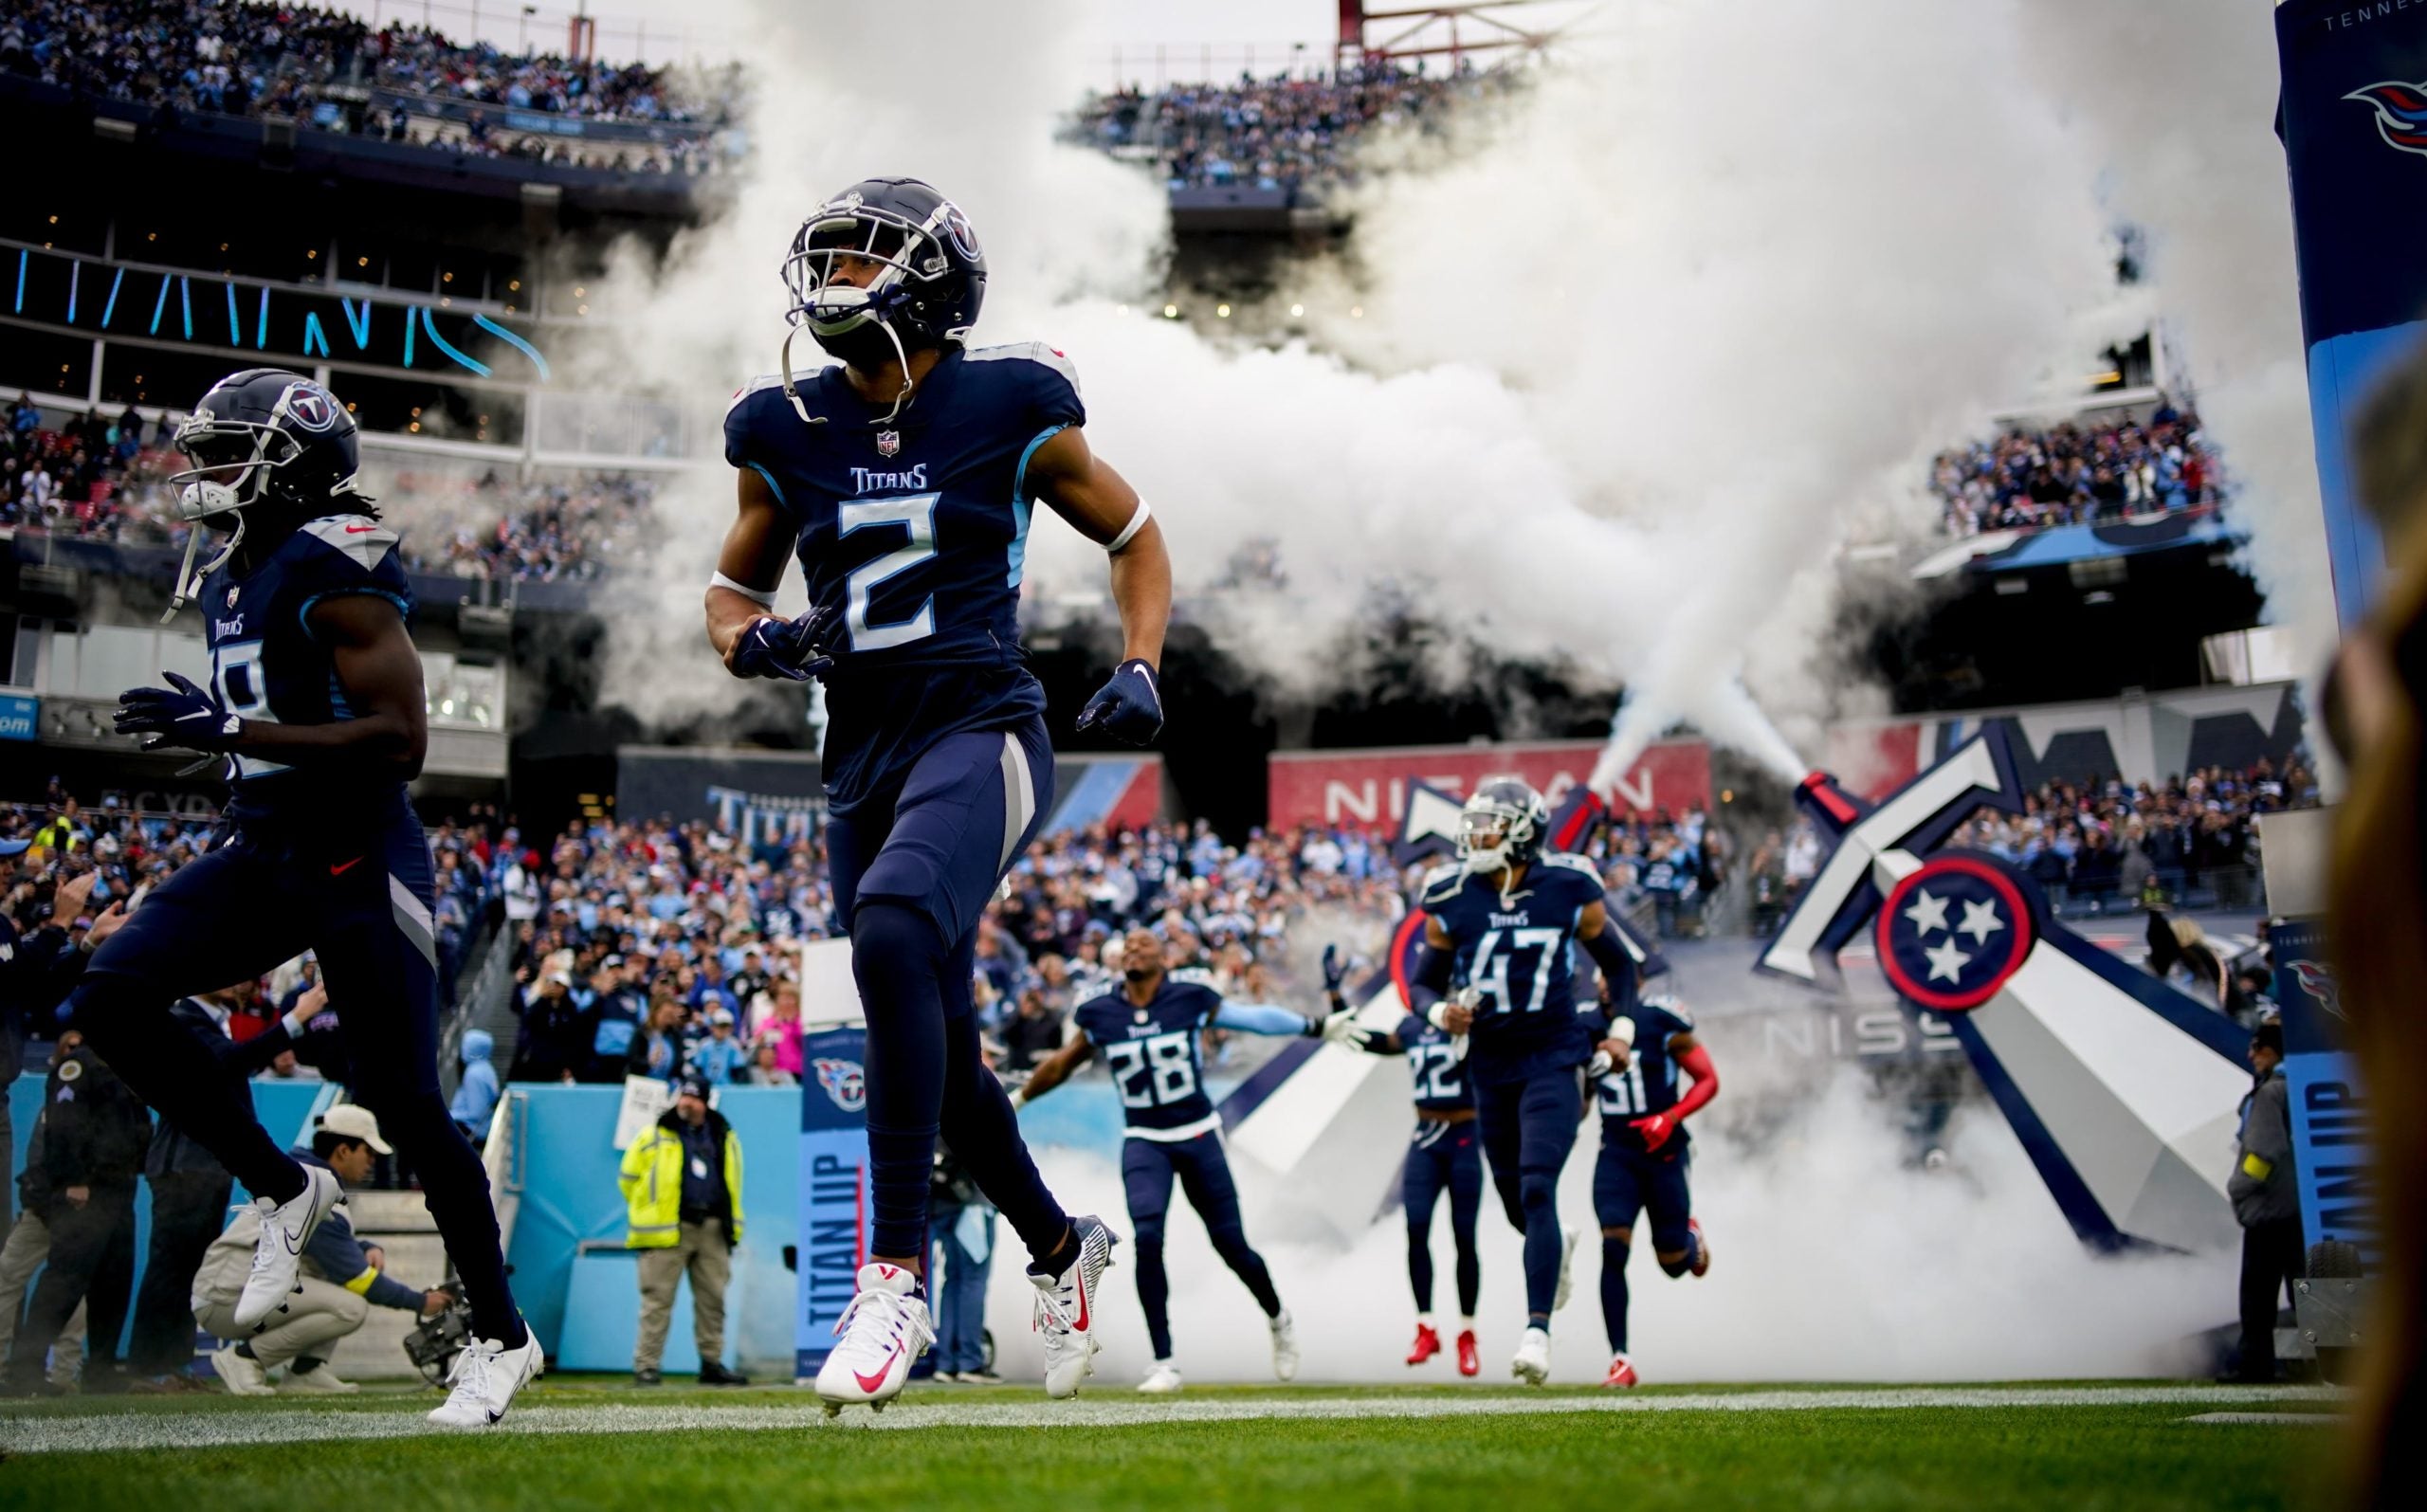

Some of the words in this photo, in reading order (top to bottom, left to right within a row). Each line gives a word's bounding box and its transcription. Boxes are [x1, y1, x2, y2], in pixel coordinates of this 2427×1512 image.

[2324, 0, 2425, 31] TENNE
[850, 463, 927, 495] TITANS
[838, 491, 942, 653] 2
[215, 612, 245, 642] TITANS
[1469, 926, 1565, 1013] 47
[1104, 1029, 1196, 1109] 28
[1406, 1043, 1462, 1101] 22
[811, 1154, 859, 1206] UP
[809, 1219, 859, 1326] TITAN
